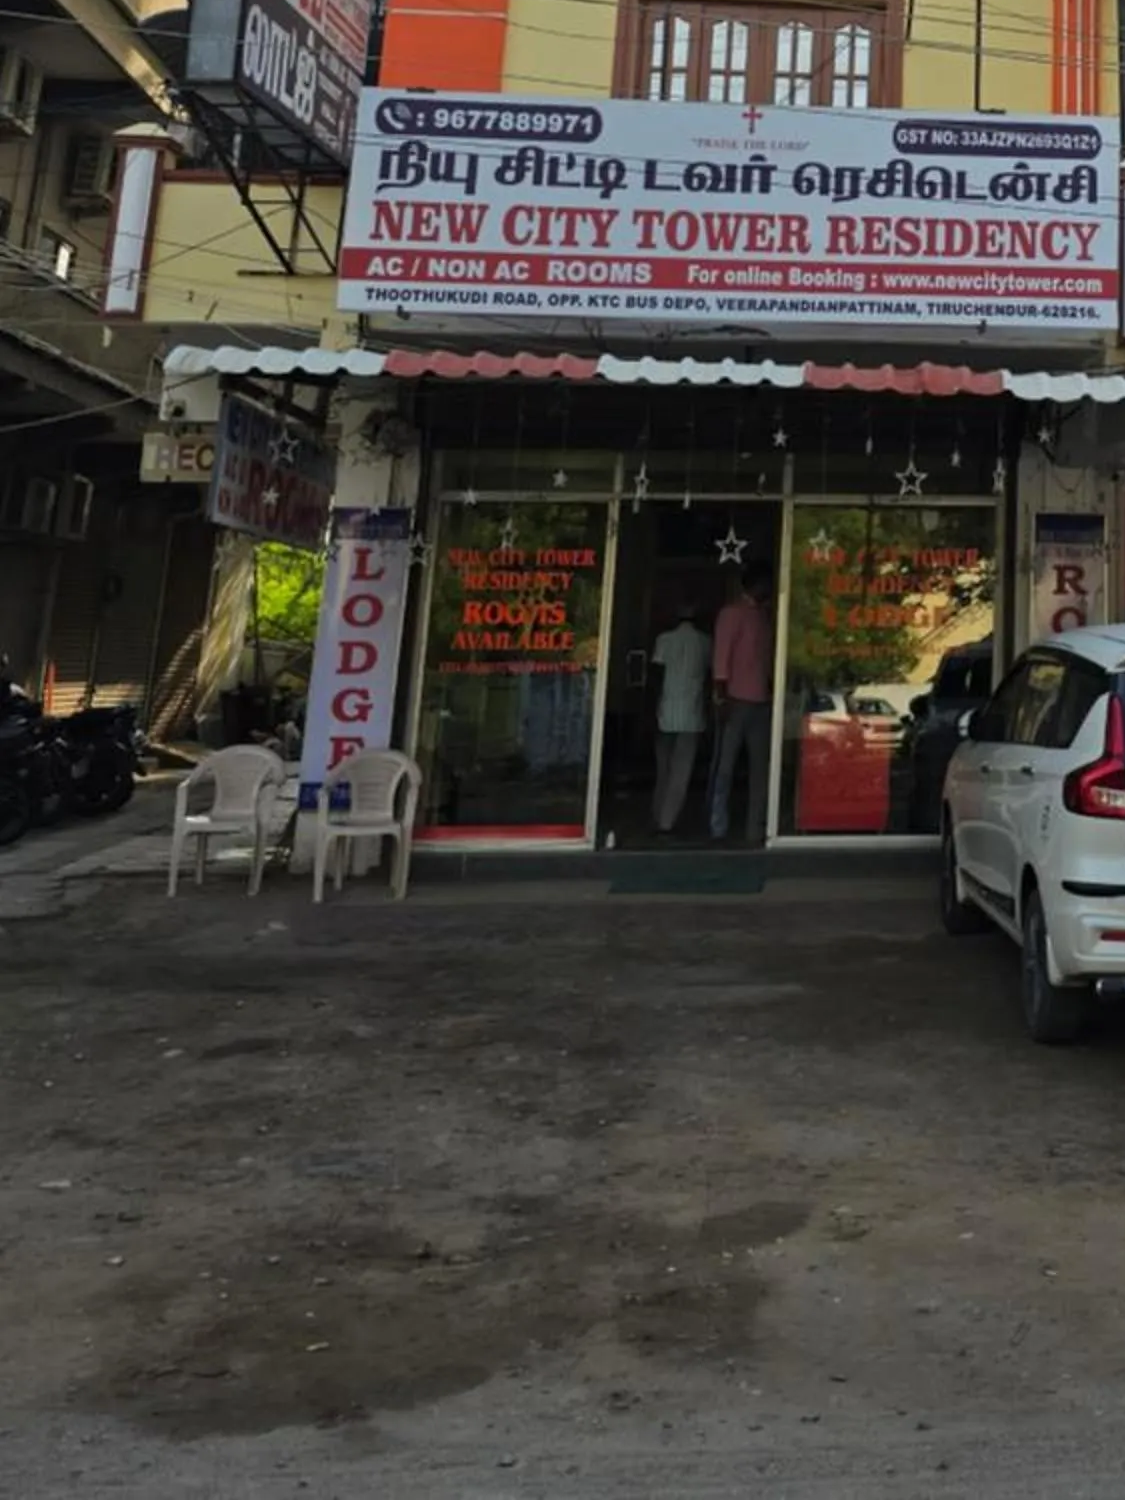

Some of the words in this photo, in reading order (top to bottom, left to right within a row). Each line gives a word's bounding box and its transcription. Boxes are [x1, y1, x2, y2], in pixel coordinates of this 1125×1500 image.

[433, 108, 595, 135] 9677889971
[897, 128, 929, 145] GST
[931, 131, 958, 147] NO:
[493, 145, 629, 200] சிட்டி
[644, 154, 778, 195] டவர்
[793, 158, 1099, 205] ரெசிடென்சி
[369, 200, 490, 244] NEW
[502, 204, 619, 248] CITY
[632, 209, 812, 255] TOWER
[825, 214, 1101, 262] RESIDENCY
[366, 255, 405, 277] AC
[427, 257, 486, 279] NON
[492, 259, 530, 281] AC
[546, 261, 652, 285] ROOMS
[688, 266, 718, 284] For
[724, 266, 782, 287] online
[788, 268, 865, 292] Booking
[882, 271, 1103, 295] www.newcitytower.com
[365, 286, 488, 306] THOOTHUKUDI
[492, 290, 542, 308] ROAD,
[587, 294, 620, 309] KTC
[625, 295, 658, 310] BUS
[716, 297, 922, 317] VEERAPANDIANPATTINAM,
[535, 548, 596, 567] TOWER
[461, 570, 573, 590] RESIDENCY
[462, 598, 566, 626] ROOMS
[450, 629, 575, 651] AVAILABLE
